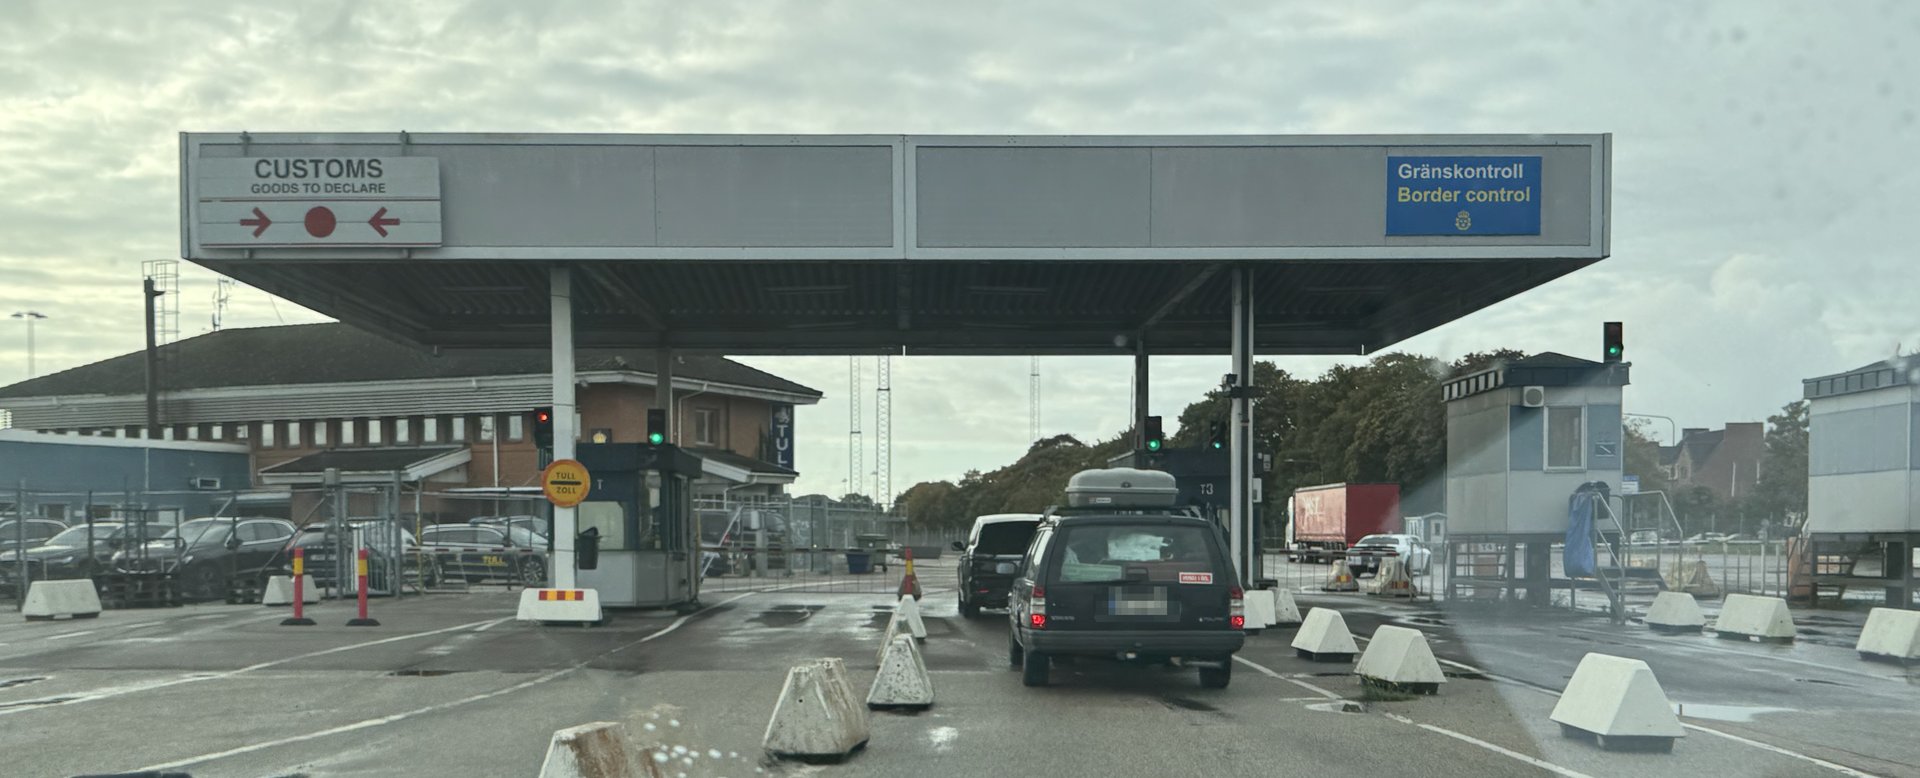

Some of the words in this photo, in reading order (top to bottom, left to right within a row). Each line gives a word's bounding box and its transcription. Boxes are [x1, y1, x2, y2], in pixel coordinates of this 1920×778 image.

[254, 158, 384, 179] CUSTOMS
[1398, 163, 1524, 179] Gränskontroll
[251, 182, 300, 194] GOODS
[304, 182, 321, 194] TO
[325, 182, 386, 194] DECLARE
[1398, 186, 1461, 202] Border
[1465, 186, 1531, 202] control
[776, 424, 789, 468] TUL
[556, 472, 576, 480] TULL
[556, 486, 576, 494] ZOLL
[1200, 483, 1214, 495] T3
